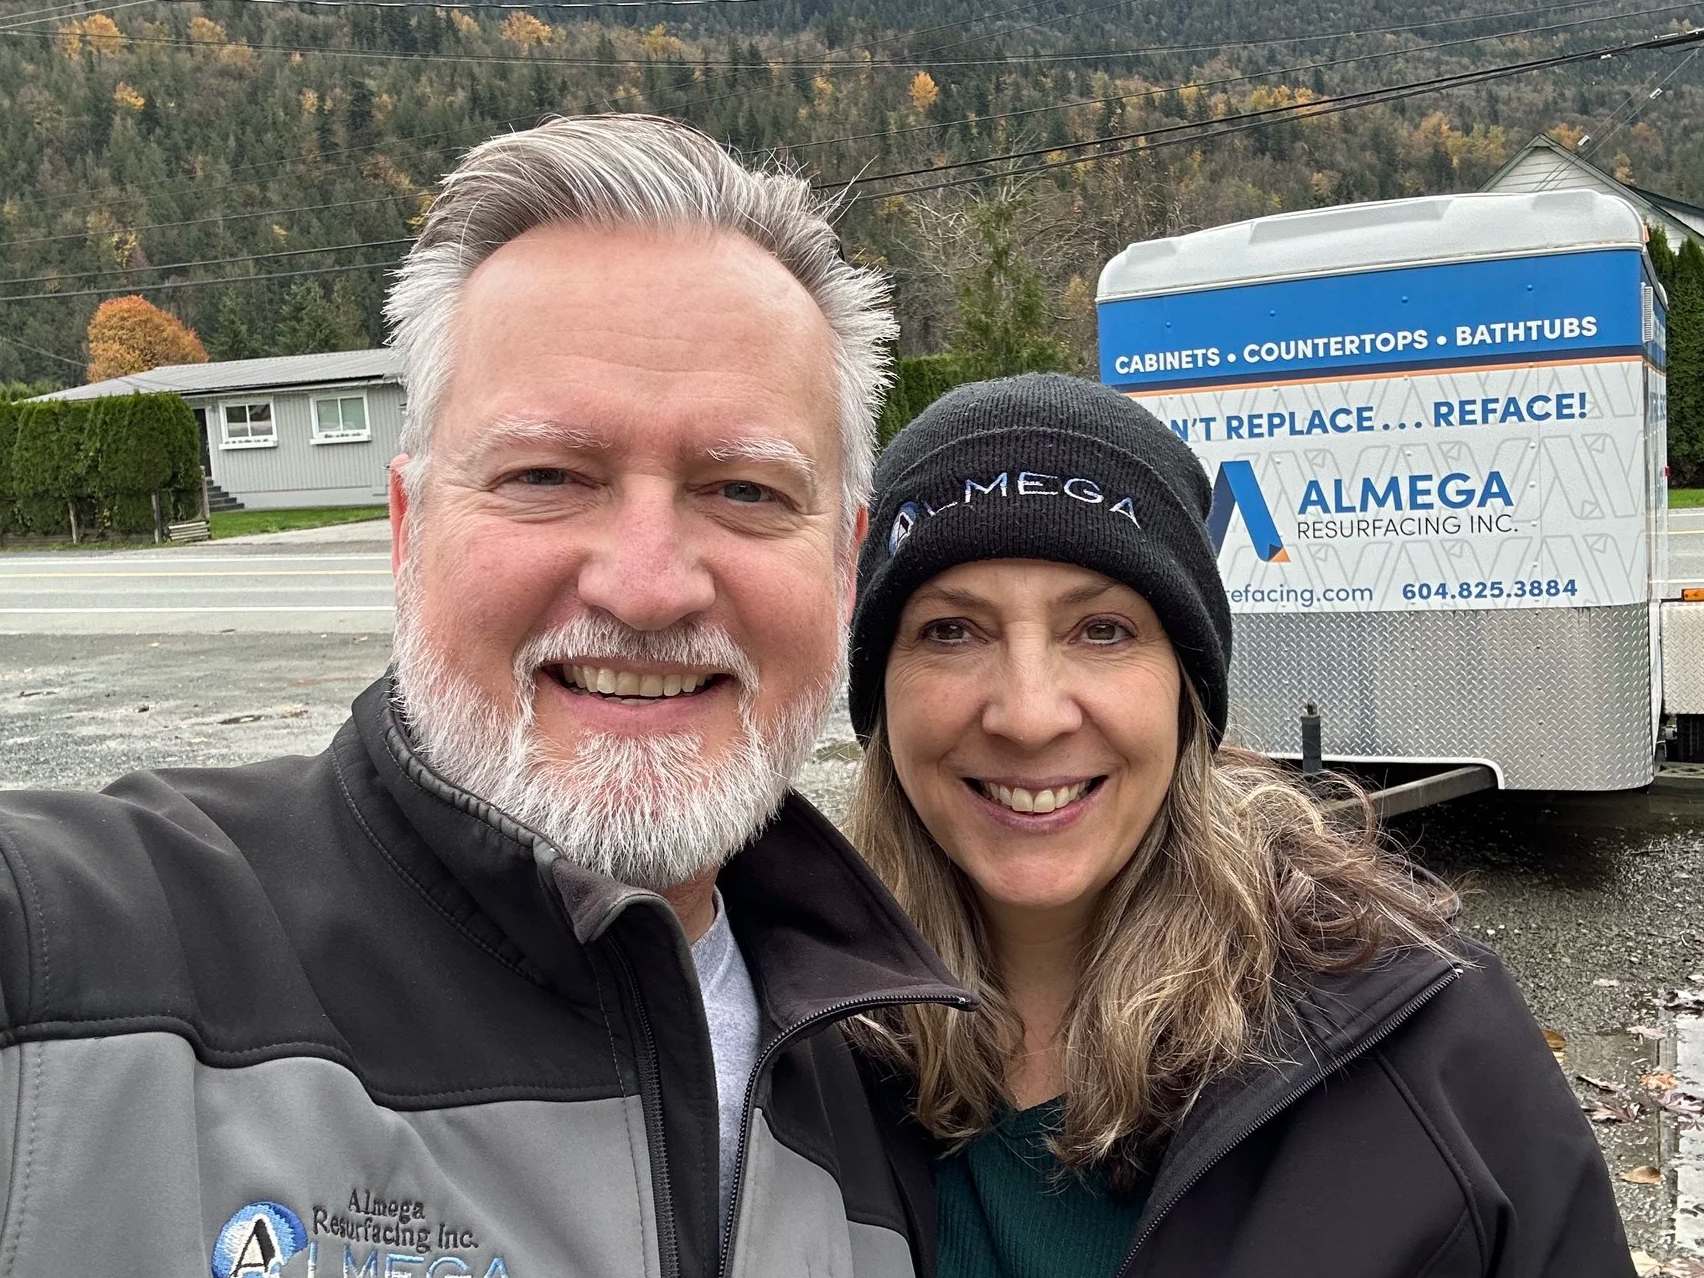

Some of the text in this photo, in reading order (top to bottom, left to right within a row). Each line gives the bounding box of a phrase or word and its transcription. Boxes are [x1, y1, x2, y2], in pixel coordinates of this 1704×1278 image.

[1115, 316, 1598, 375] CABINETS COUNTERTOPS BATHTUBS
[1170, 416, 1217, 442] N'T
[1433, 392, 1587, 428] REFACE!
[1297, 470, 1514, 516] ALMEGA
[1297, 513, 1519, 540] RESURFACING INC.
[1225, 579, 1578, 608] efacing.com 604.825.3884
[347, 1188, 427, 1222] Almega
[311, 1205, 479, 1254] Resurfacing Inc.
